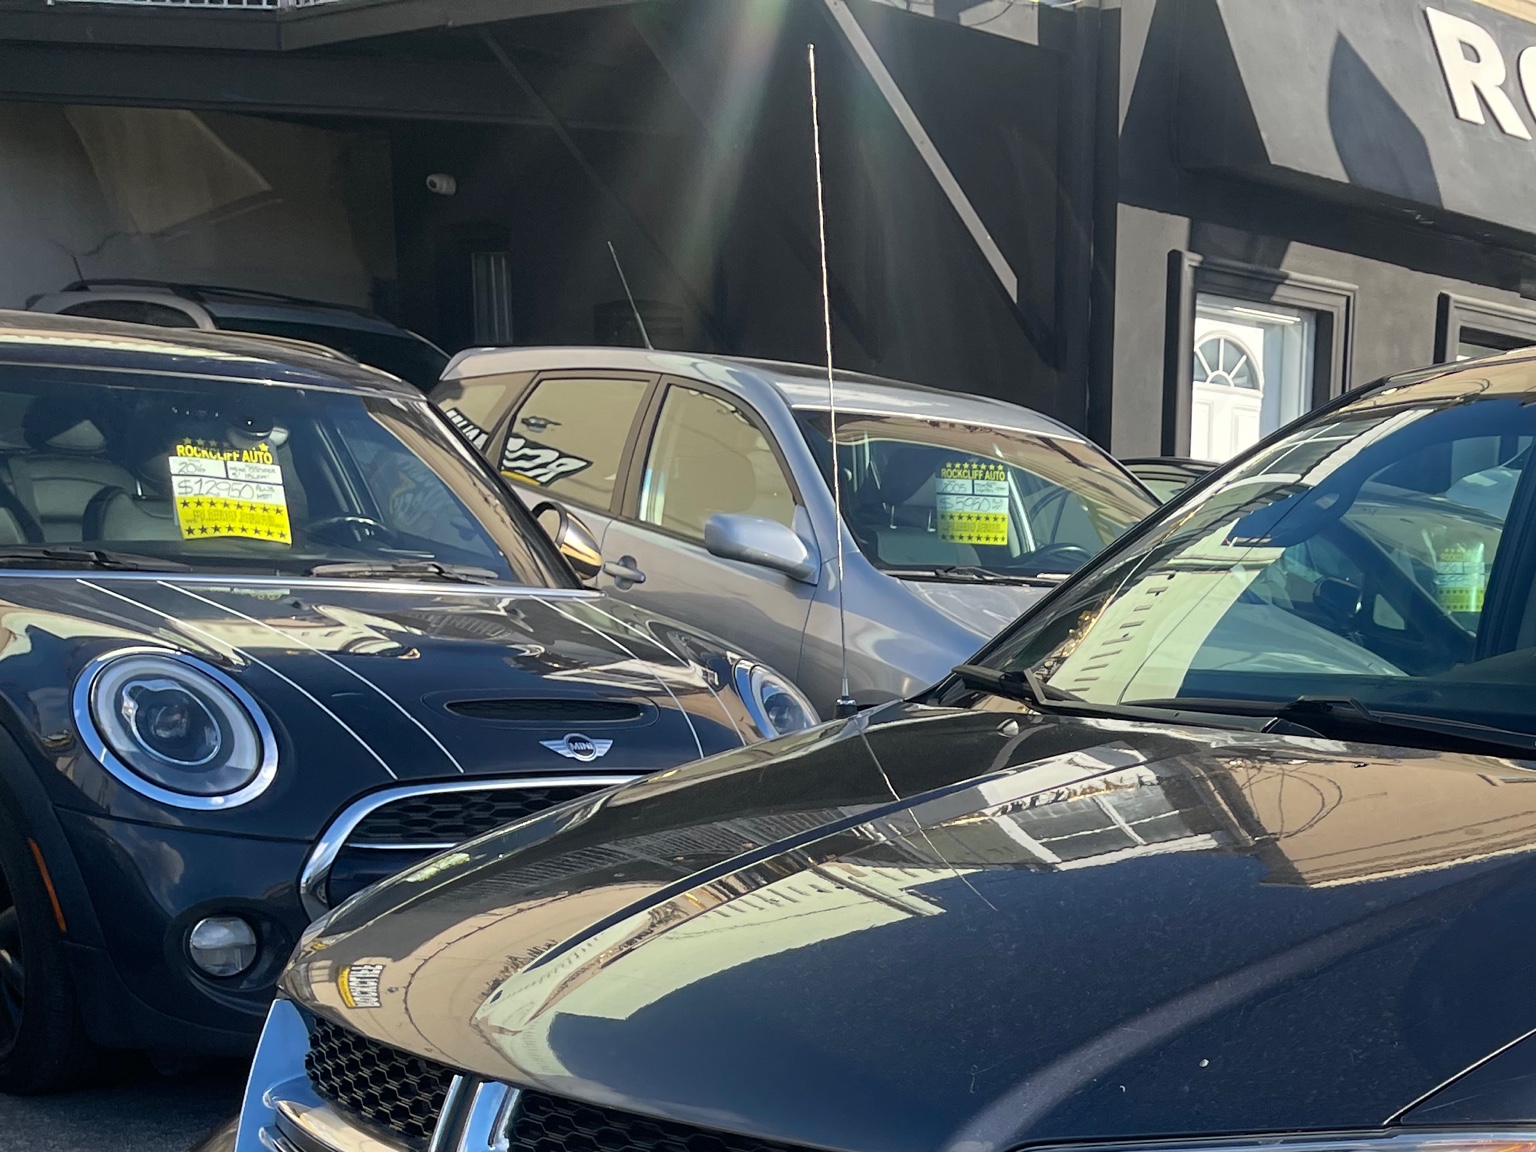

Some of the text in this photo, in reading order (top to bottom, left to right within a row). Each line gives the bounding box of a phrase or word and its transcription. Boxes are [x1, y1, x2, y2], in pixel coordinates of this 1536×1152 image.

[177, 445, 273, 465] ROCKCLIFF AUTO
[941, 468, 1005, 481] ROCKCLIFF AUTO
[569, 742, 593, 750] MINI
